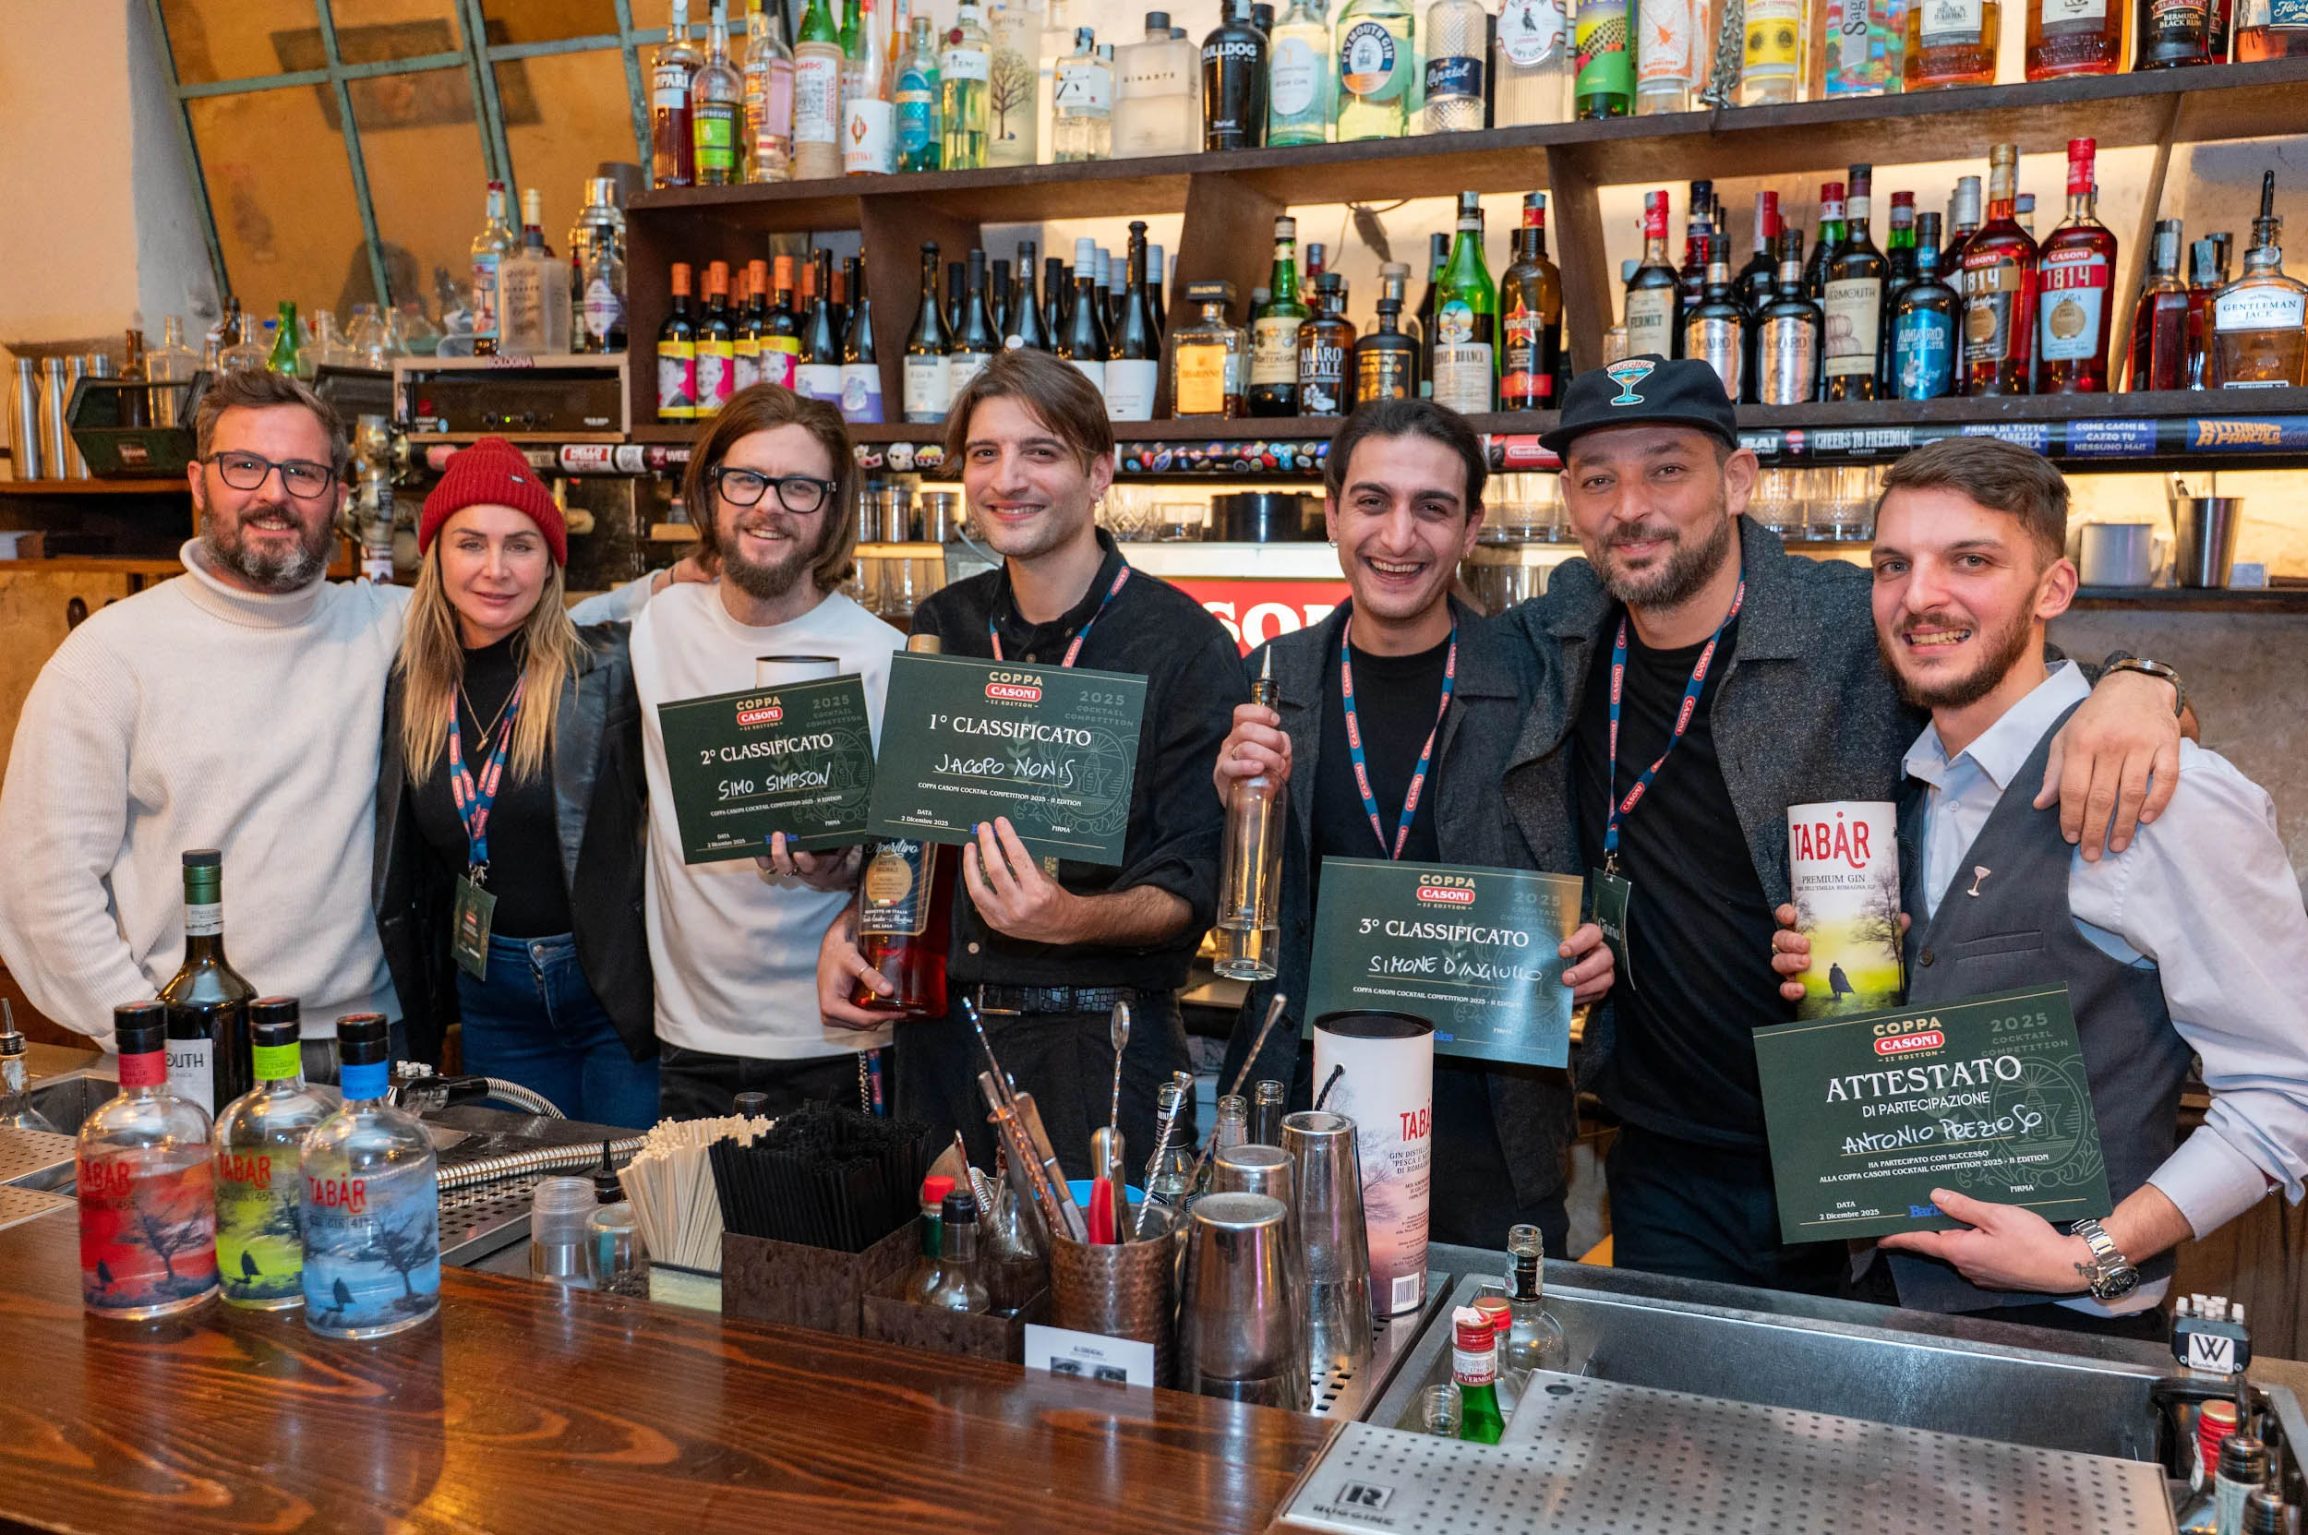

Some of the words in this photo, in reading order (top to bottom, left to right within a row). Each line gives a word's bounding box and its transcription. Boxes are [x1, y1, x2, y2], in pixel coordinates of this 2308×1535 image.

[2159, 20, 2186, 28] BLACK
[2163, 13, 2199, 21] BERMUDA
[1342, 24, 1385, 63] PLYMOUTH
[1381, 40, 1394, 59] GIN
[1965, 254, 1997, 267] CASONI
[2051, 250, 2088, 261] CASONI
[1964, 267, 1999, 292] 1814
[2046, 266, 2090, 289] 1814
[1827, 287, 1876, 300] VERMOUTH
[2223, 300, 2297, 312] GENTLEMAN
[1630, 314, 1662, 328] FERNET
[2246, 311, 2273, 320] JACK
[1301, 347, 1342, 362] AMARO
[1300, 361, 1342, 377] LOCALE
[1964, 425, 1996, 433] PRIMA
[2013, 424, 2047, 432] TUTTO
[2075, 422, 2104, 431] COME
[1814, 432, 1851, 449] CHEERS
[1851, 431, 1865, 448] TO
[1866, 430, 1911, 447] FREEDOM
[2121, 432, 2136, 441] TU
[2074, 443, 2122, 451] NESSUNO
[1695, 642, 1714, 680] CASONI
[989, 671, 1043, 686] COPPA
[1613, 665, 1623, 702] CASONI
[991, 686, 1037, 699] CASONI
[1079, 690, 1125, 706] 2025
[736, 695, 782, 711] COPPA
[812, 694, 850, 709] 2025
[741, 709, 779, 722] CASONI
[1076, 705, 1124, 716] COCKTAIL
[1675, 697, 1694, 735] CASONI
[1064, 712, 1134, 727] COMPETITION
[953, 716, 1092, 746] CLASSIFICATO
[720, 733, 833, 762] CLASSIFICATO
[934, 753, 1004, 775] JACOPO
[1014, 758, 1075, 786] NONIS
[718, 779, 754, 801] SIMO
[766, 761, 831, 792] SIMPSON
[917, 782, 937, 790] COPPA
[938, 784, 959, 792] CASONI
[960, 786, 989, 796] COCKTAIL
[989, 790, 1029, 800] COMPETITION
[1056, 798, 1082, 807] EDITION
[1407, 776, 1422, 810] CASONI
[1622, 784, 1644, 813] CASONI
[1051, 825, 1071, 833] FIRMA
[1419, 873, 1476, 889] COPPA
[1802, 873, 1844, 884] PREMIUM
[1848, 873, 1866, 883] GIN
[1422, 889, 1470, 901] CASONI
[1514, 891, 1562, 907] 2025
[1384, 920, 1529, 947] CLASSIFICATO
[1368, 955, 1438, 974] SIMONE
[1352, 986, 1373, 994] COPPA
[1373, 988, 1396, 996] CASONI
[1396, 989, 1426, 999] COCKTAIL
[1427, 993, 1469, 1003] COMPETITION
[1873, 1016, 1942, 1037] COPPA
[1990, 1012, 2048, 1033] 2025
[1881, 1034, 1938, 1051] CASONI
[1992, 1030, 2053, 1045] COCKTAIL
[1898, 1050, 1938, 1061] EDITION
[1981, 1038, 2069, 1058] COMPETITION
[166, 1052, 204, 1068] OUTH
[1826, 1054, 2022, 1103] ATTESTATO
[1862, 1103, 1877, 1118] DI
[1878, 1091, 1991, 1117] PARTECIPAZIONE
[1841, 1124, 1933, 1156] ANTONIO
[1389, 1152, 1403, 1160] GIN
[1868, 1160, 1879, 1169] HA
[1879, 1155, 1929, 1168] PARTECIPATO
[1929, 1154, 1947, 1162] CON
[1948, 1149, 1989, 1160] SUCCESSO
[1819, 1175, 1838, 1183] ALLA
[1838, 1172, 1862, 1181] COPPA
[1863, 1169, 1891, 1179] CASONI
[1891, 1165, 1930, 1176] COCKTAIL
[1930, 1160, 1982, 1172] COMPETITION
[1982, 1158, 2003, 1168] 2025
[2016, 1153, 2049, 1164] EDITION
[2010, 1185, 2035, 1194] FIRMA
[1836, 1201, 1856, 1209] DATA
[1819, 1213, 1825, 1221] 2
[1825, 1210, 1859, 1220] Dicembre
[1860, 1208, 1880, 1217] 2025
[2194, 1334, 2228, 1362] W
